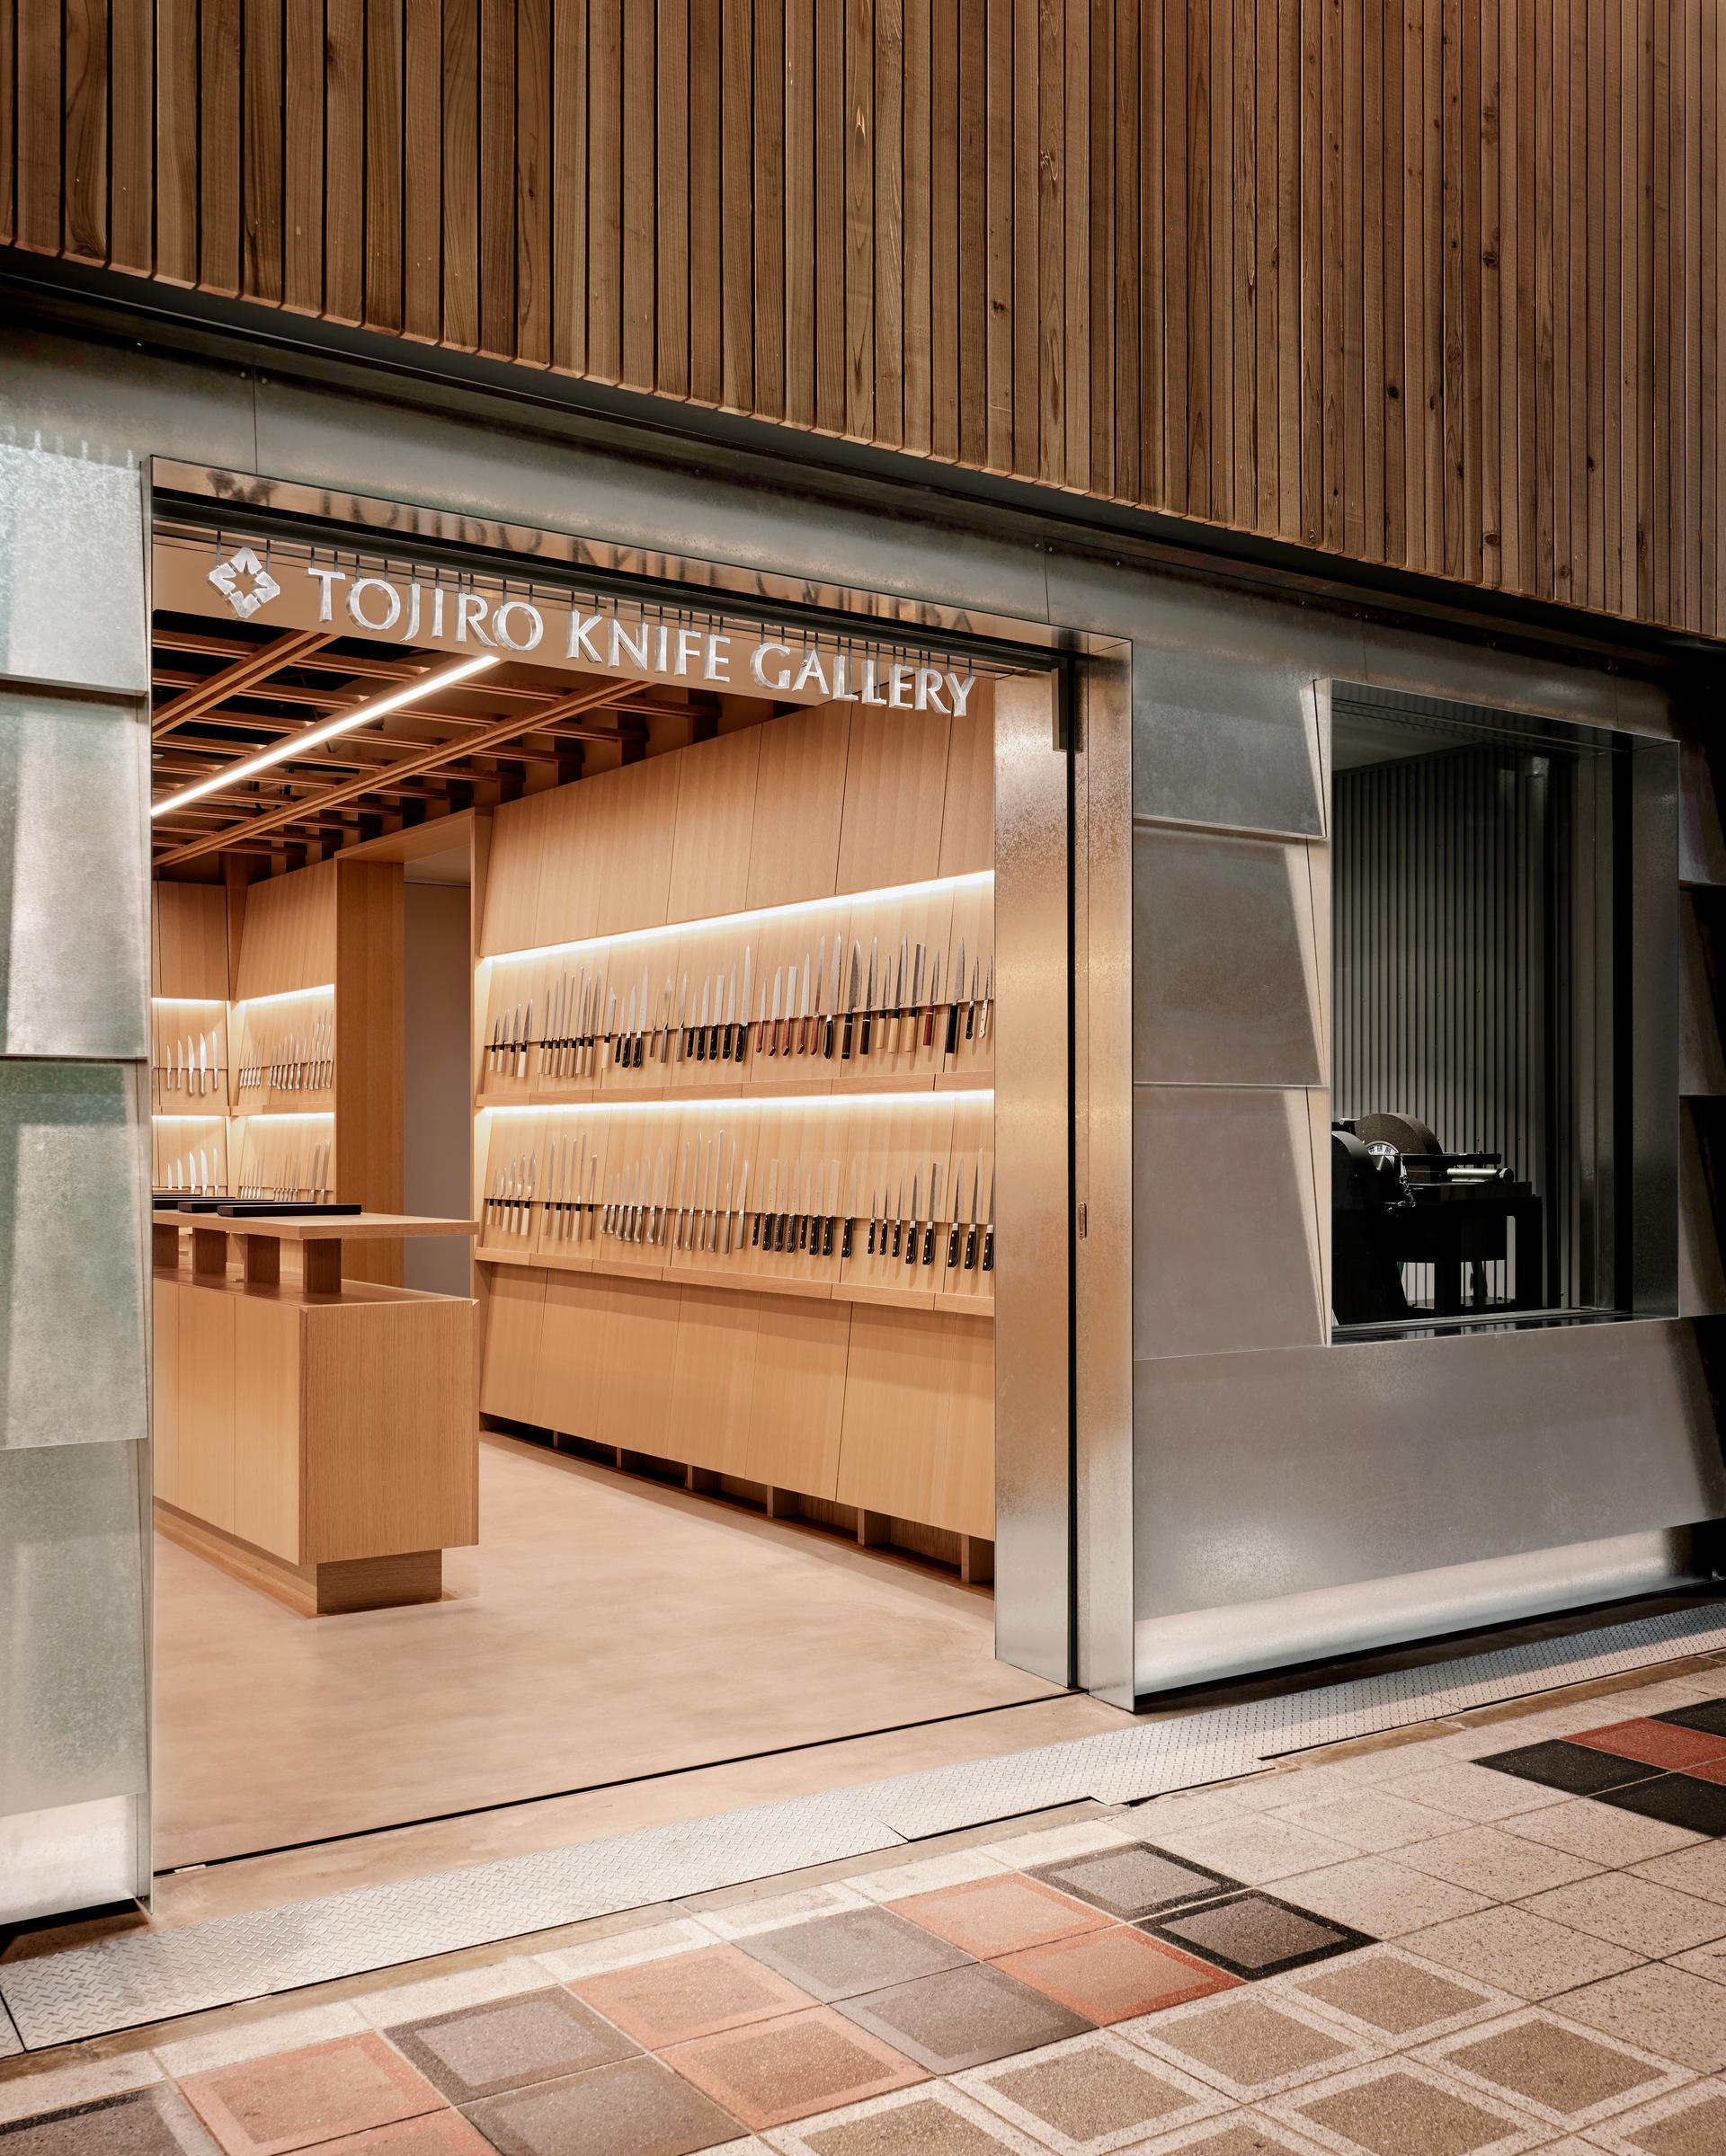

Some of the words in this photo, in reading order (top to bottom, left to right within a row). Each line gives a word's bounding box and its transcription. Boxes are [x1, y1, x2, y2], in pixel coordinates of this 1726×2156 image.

[307, 567, 544, 651] TOJIRO
[566, 610, 731, 682] KNIFE
[750, 642, 976, 717] GALLERY
